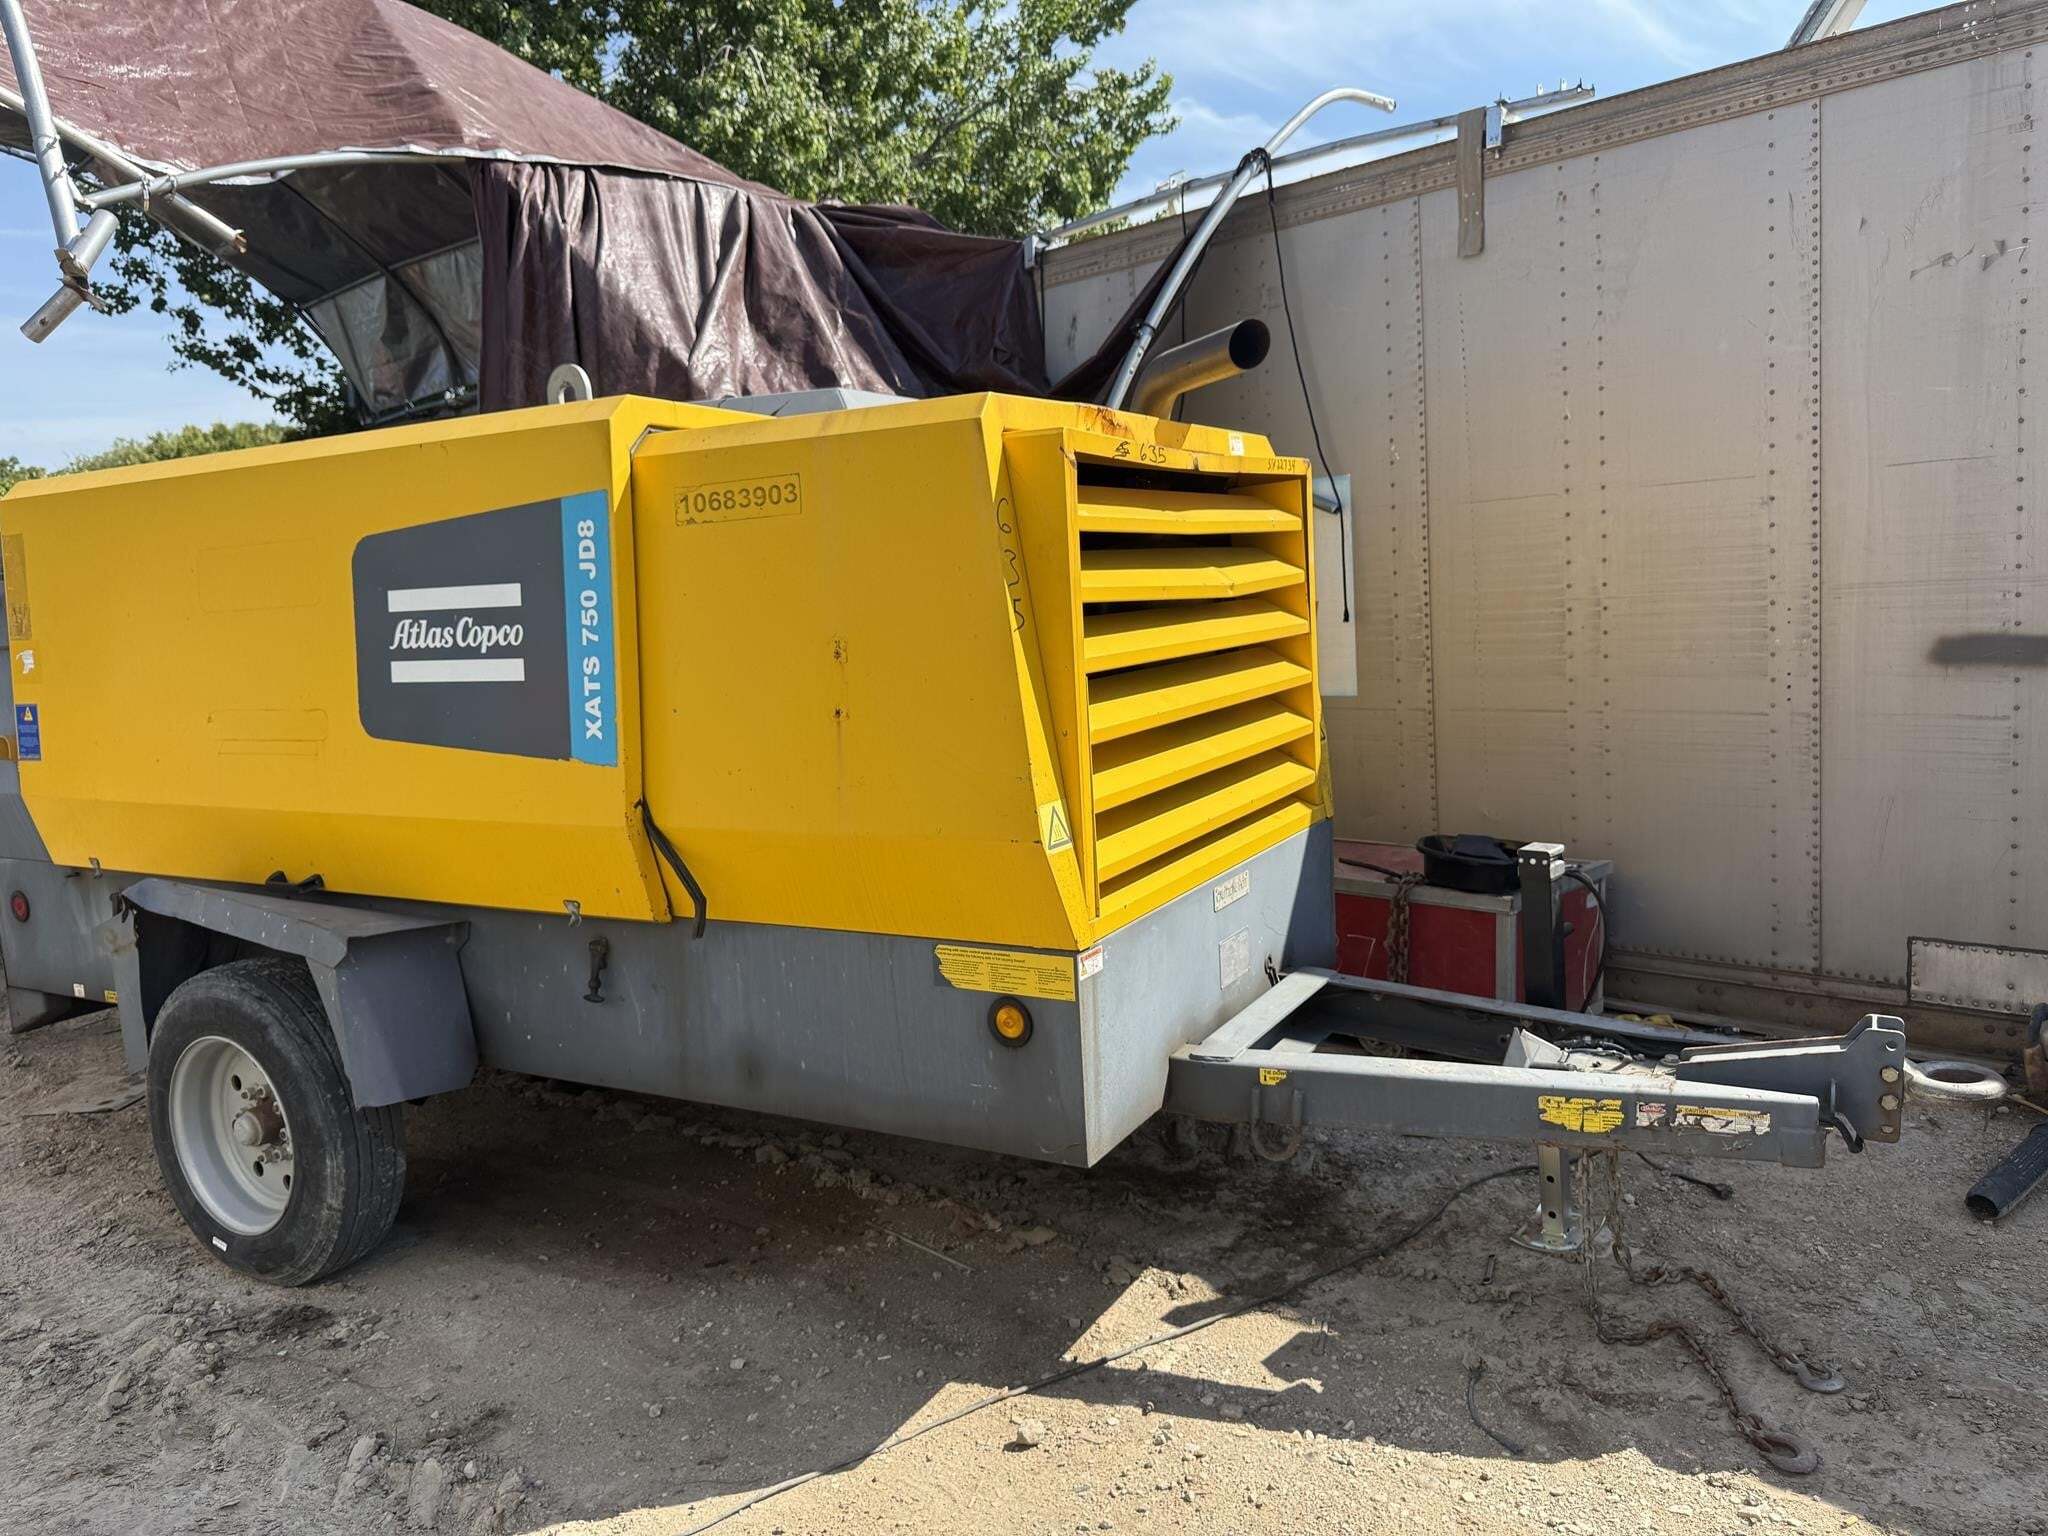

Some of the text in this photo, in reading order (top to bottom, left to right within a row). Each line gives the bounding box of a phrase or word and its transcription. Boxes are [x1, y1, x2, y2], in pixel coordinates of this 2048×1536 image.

[1139, 442, 1167, 464] 635
[680, 483, 798, 514] 10683903
[389, 616, 524, 654] Atlas Copco
[577, 519, 603, 740] XATS 750 JD8
